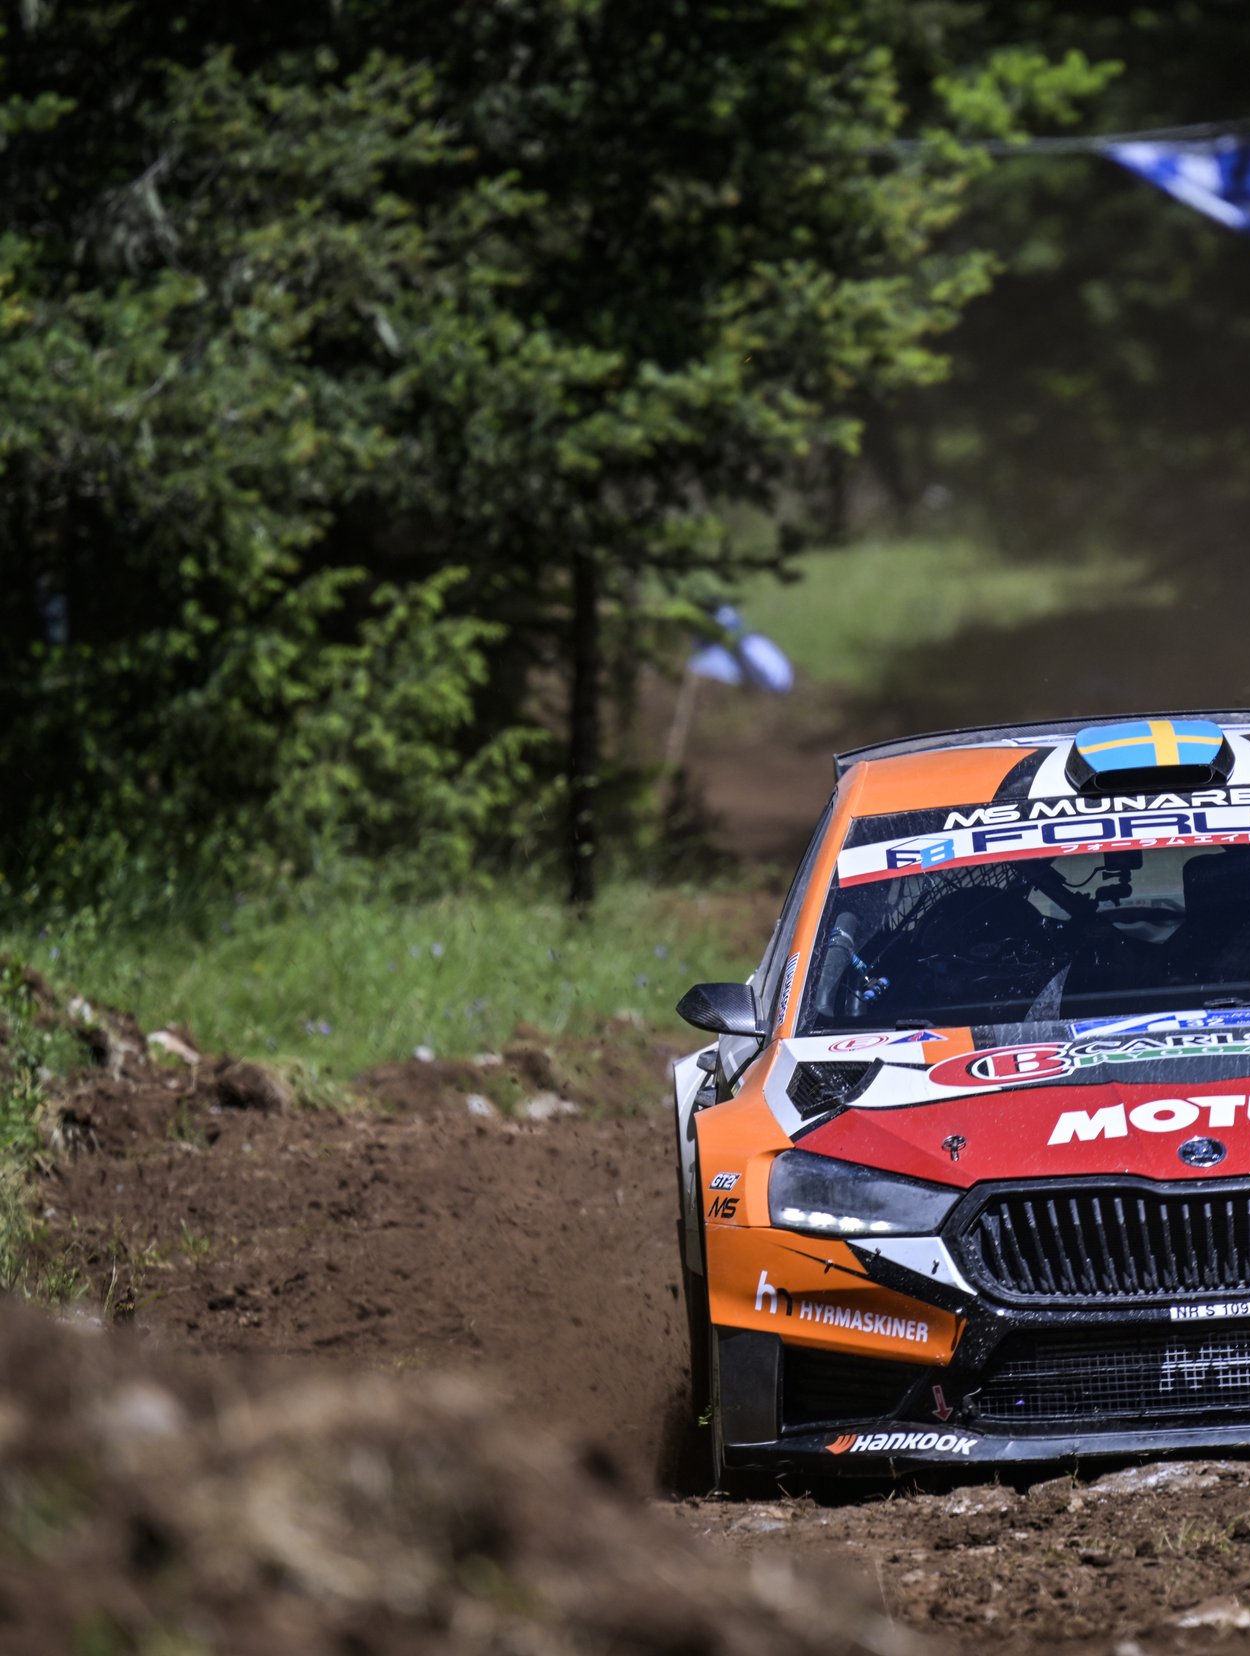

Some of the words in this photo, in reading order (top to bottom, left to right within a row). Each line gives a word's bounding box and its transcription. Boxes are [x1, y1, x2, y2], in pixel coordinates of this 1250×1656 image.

[943, 804, 1021, 830] MS
[711, 1173, 736, 1189] GT2
[708, 1197, 740, 1218] MS
[1177, 1307, 1199, 1319] NR
[1206, 1305, 1216, 1317] S
[1223, 1303, 1249, 1316] 109
[800, 1301, 929, 1343] HYRMASKINER
